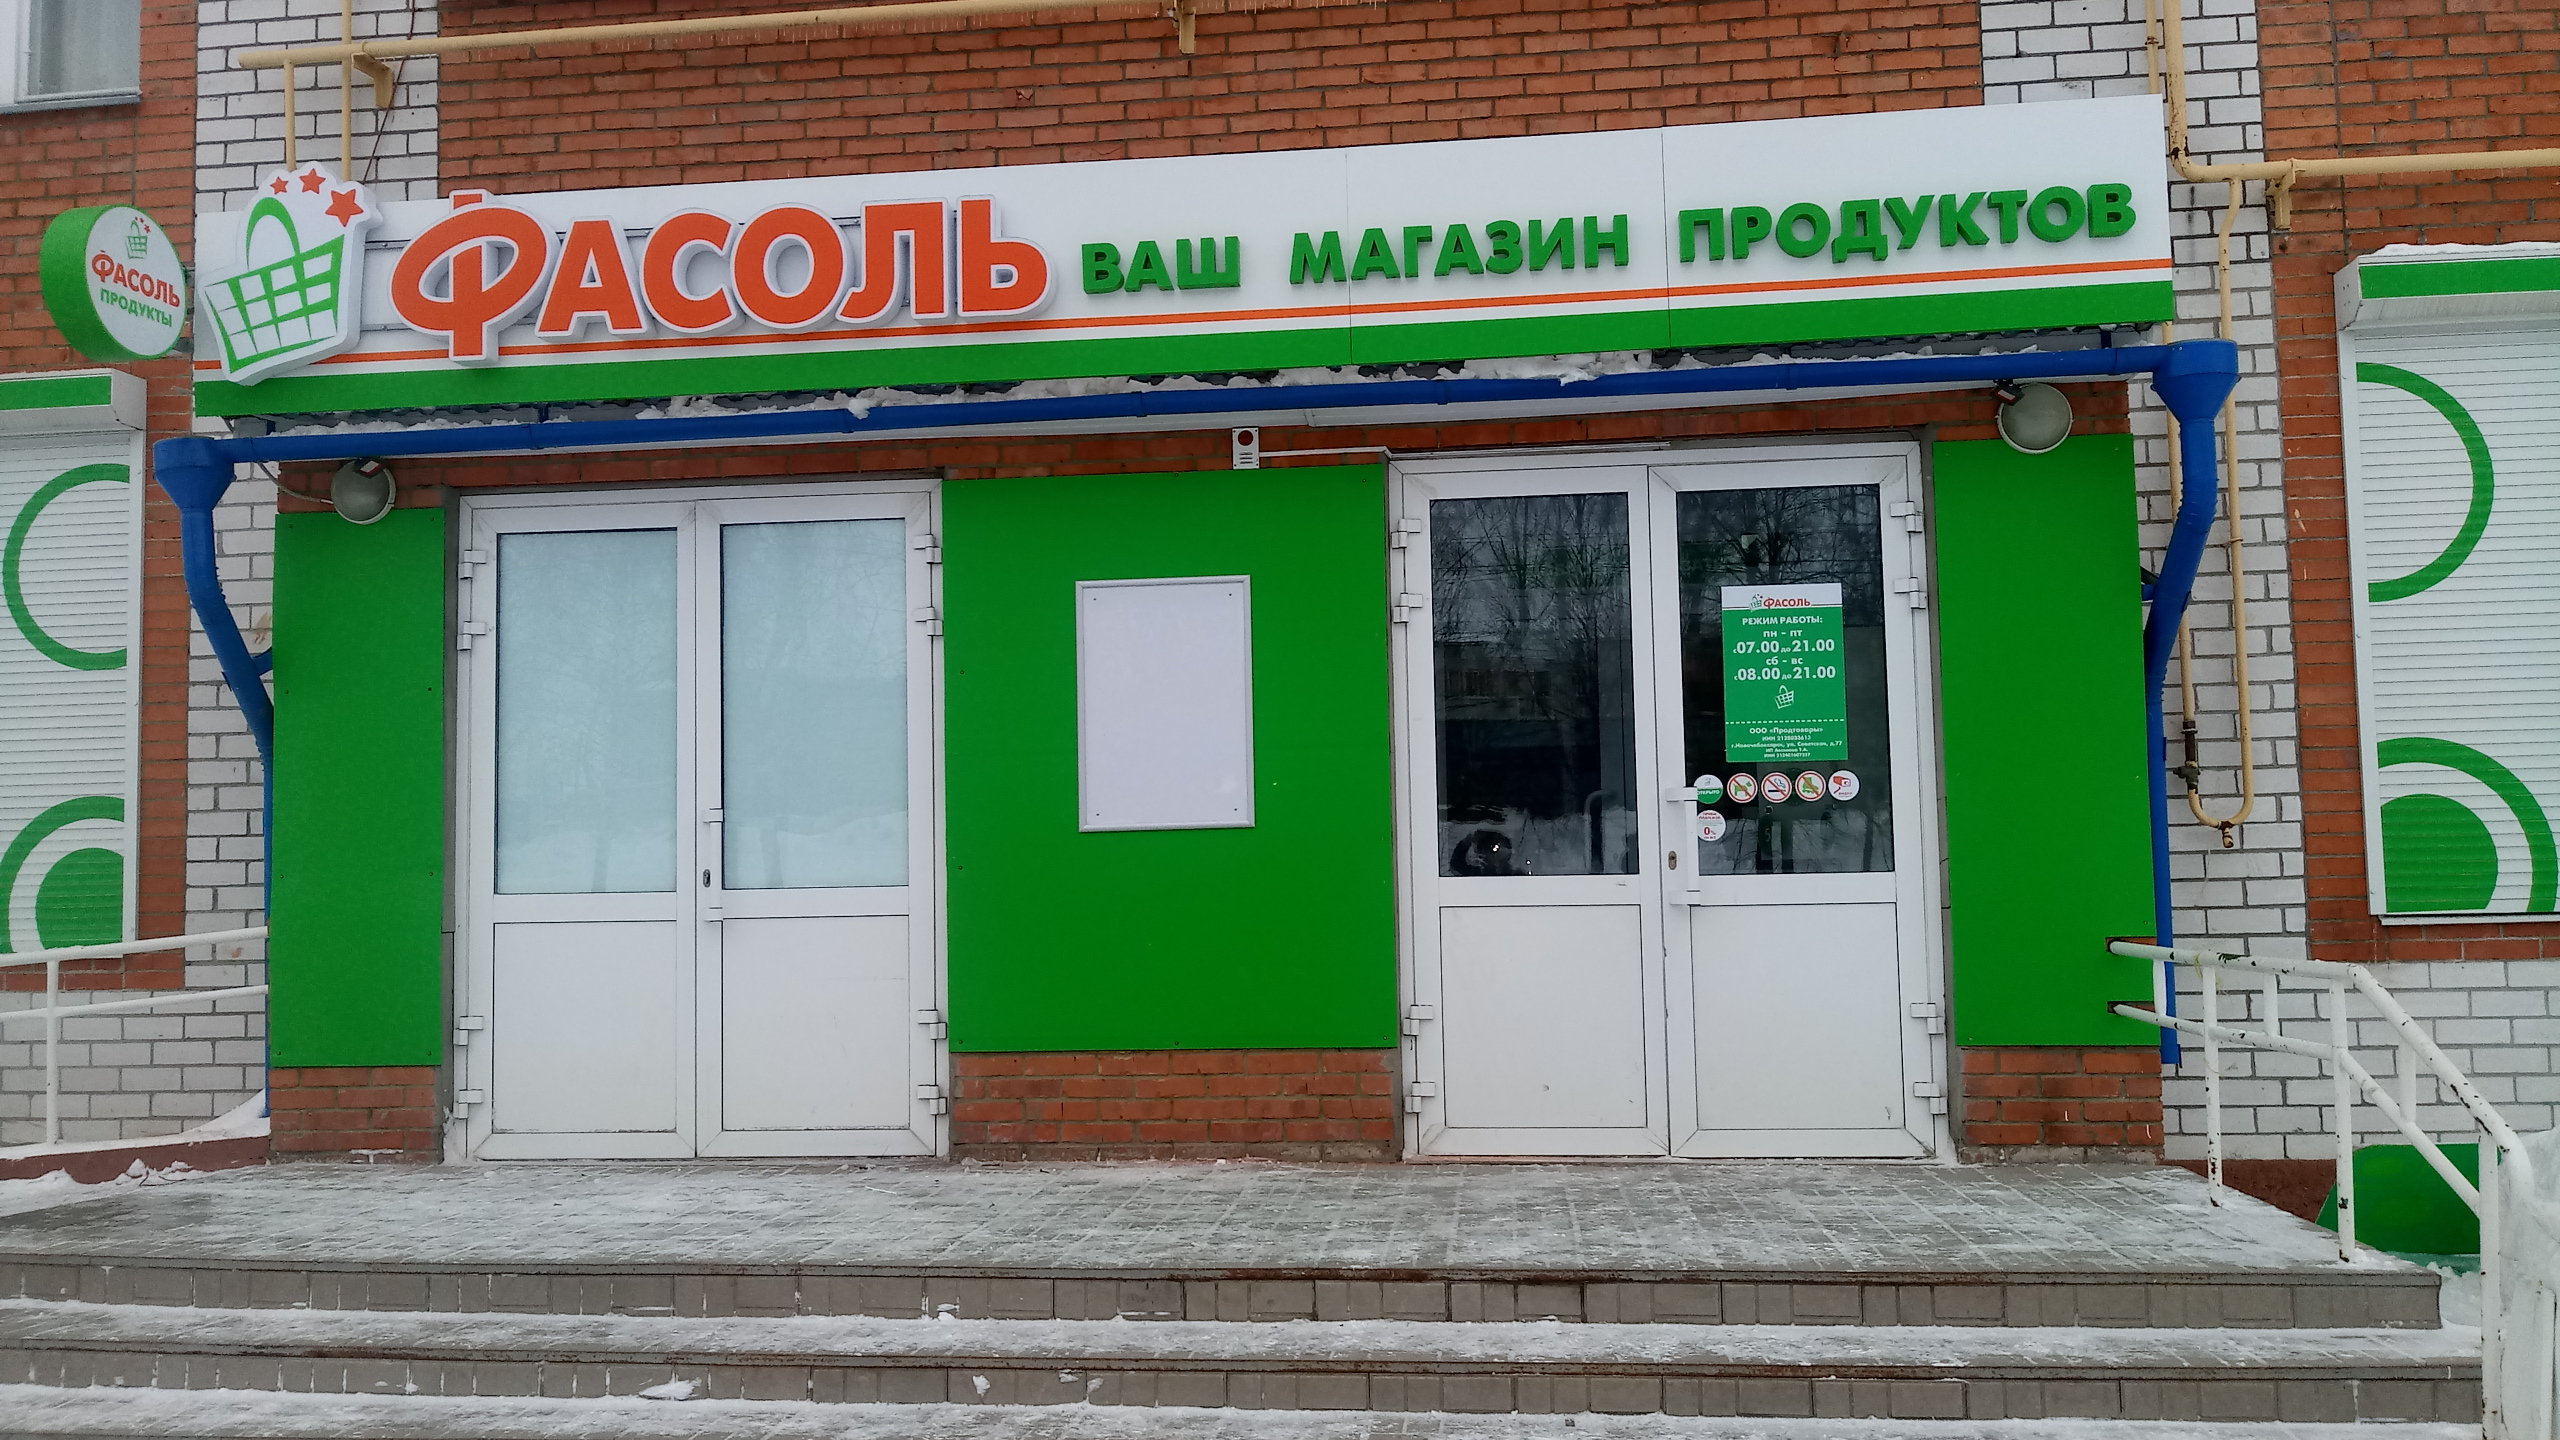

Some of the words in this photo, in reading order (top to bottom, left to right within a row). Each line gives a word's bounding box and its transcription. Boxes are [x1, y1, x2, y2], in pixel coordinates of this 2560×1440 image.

[1081, 236, 1240, 294] ВАШ
[1289, 214, 1630, 284] МАГАЗИН
[1678, 183, 2137, 263] ПРОДУКТОВ
[91, 250, 180, 307] ФАСОЛЬ
[390, 191, 1052, 360] ФАСОЛЬ
[100, 288, 172, 327] ПРОДУКТЫ
[1763, 597, 1811, 609] ФАСОЛЬ
[1742, 617, 1778, 625] РЕЖИМ
[1780, 616, 1823, 624] РАБОТЫ:
[1791, 639, 1835, 652] 21.00
[1766, 656, 1778, 665] сб
[1792, 666, 1836, 679] 21.00
